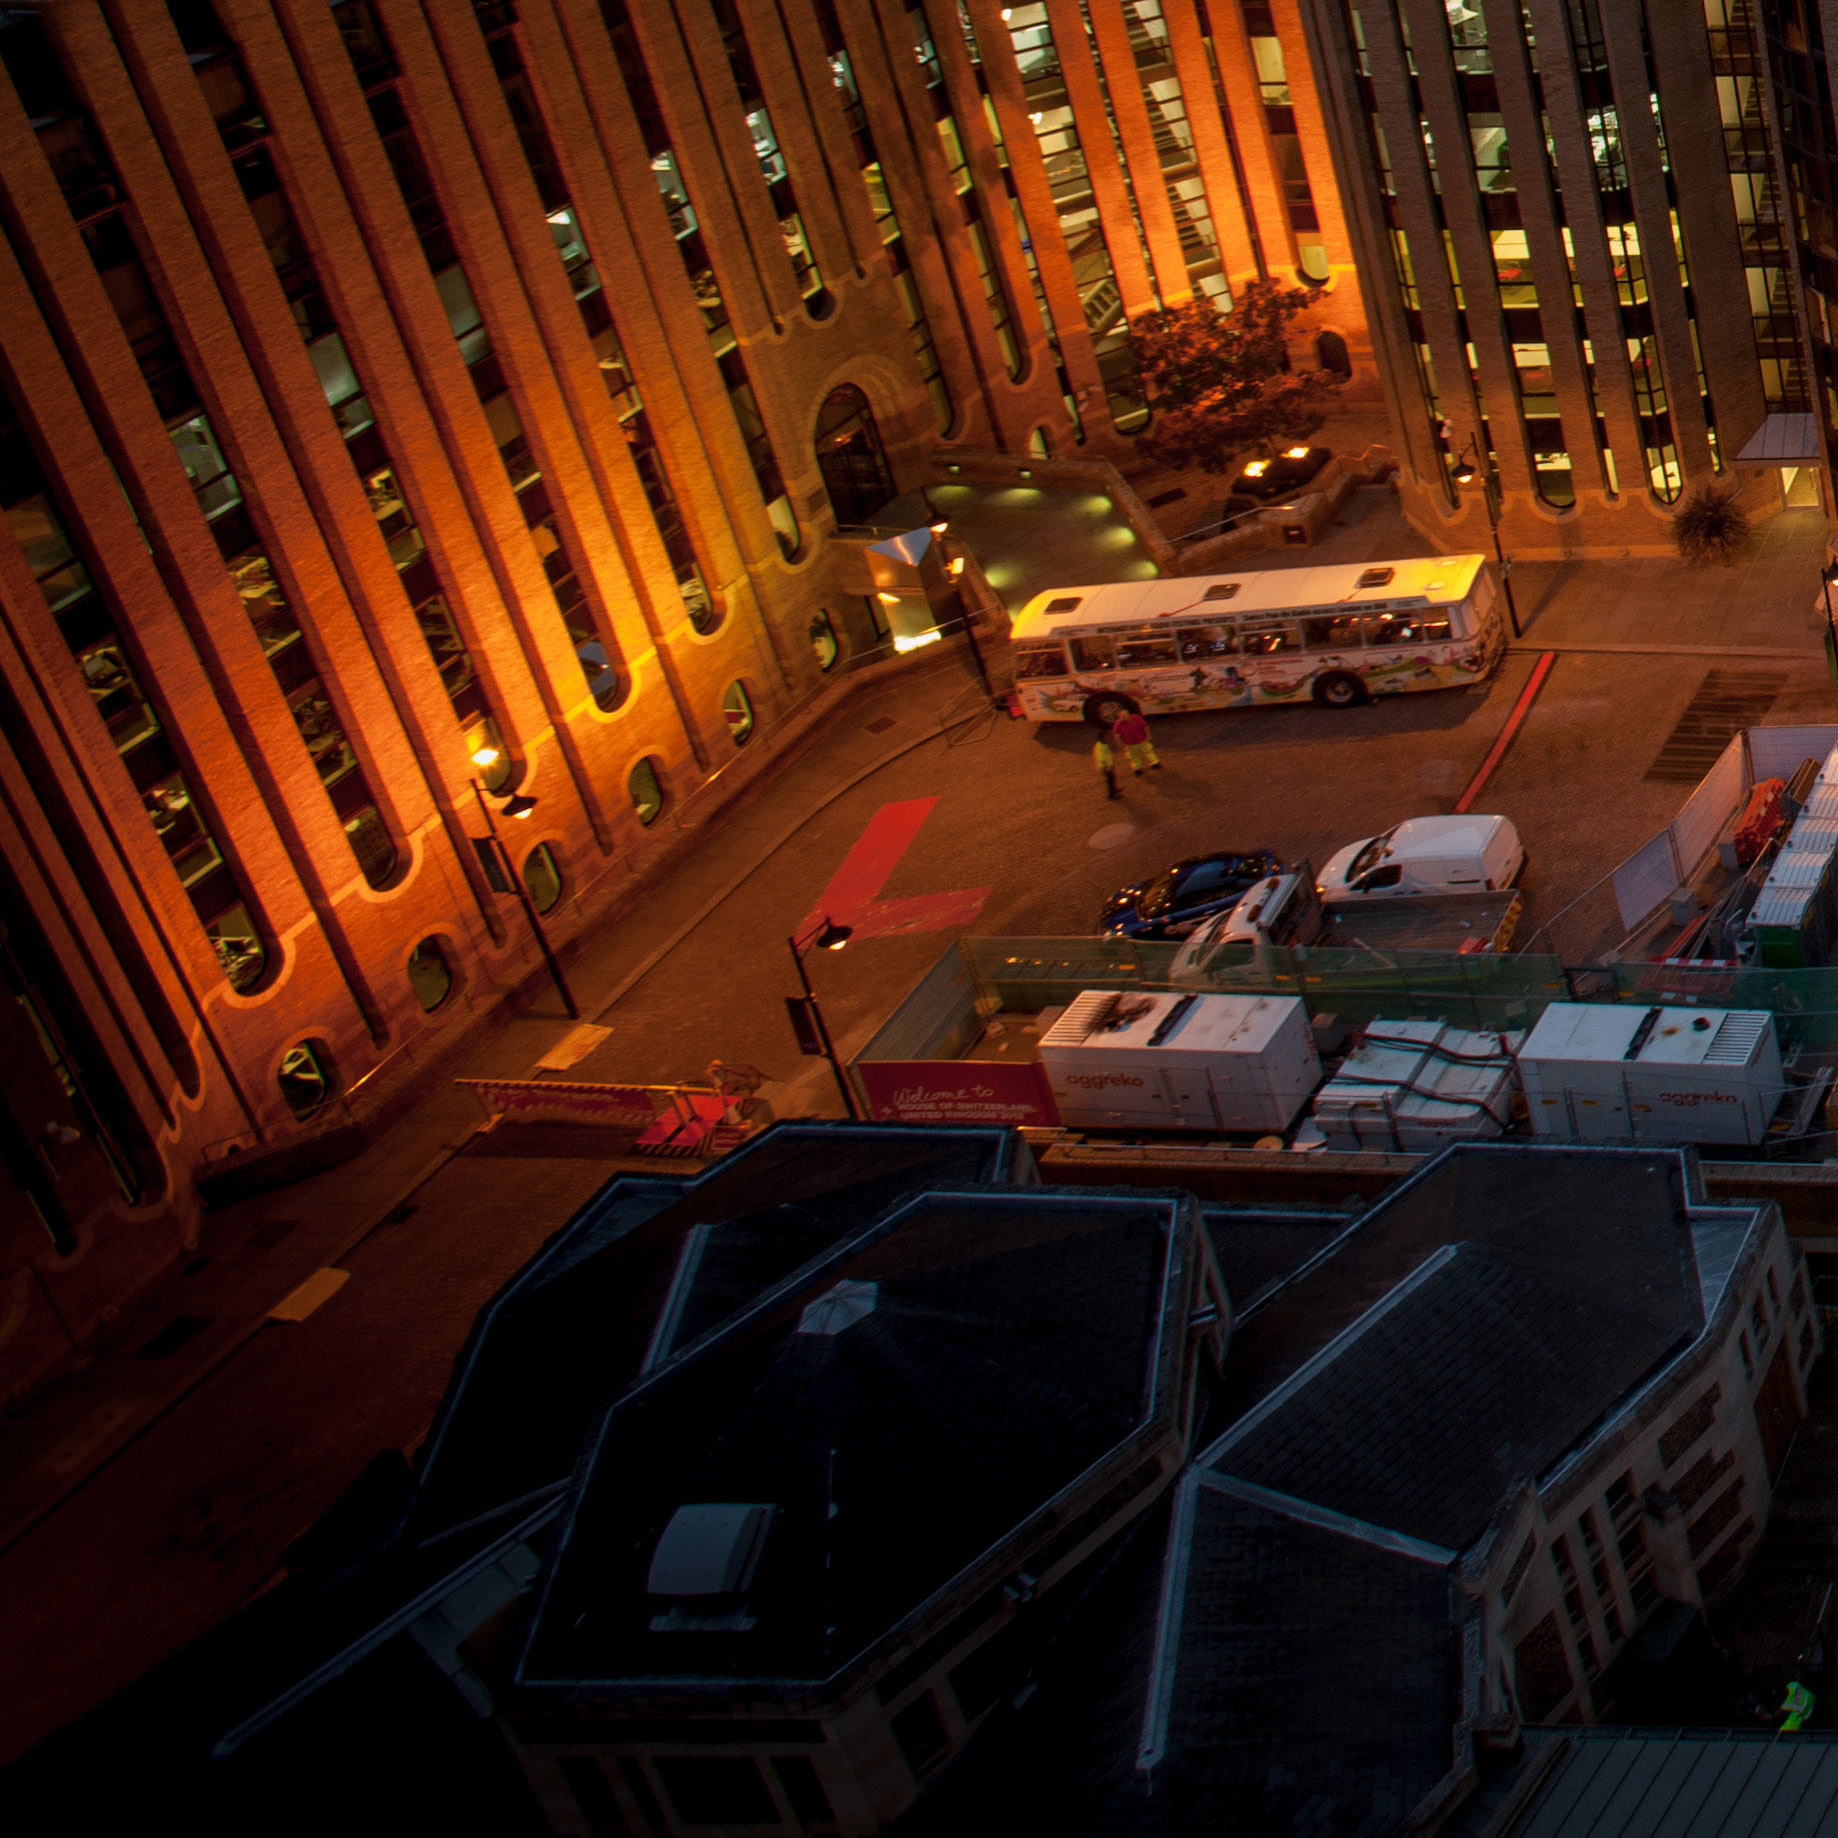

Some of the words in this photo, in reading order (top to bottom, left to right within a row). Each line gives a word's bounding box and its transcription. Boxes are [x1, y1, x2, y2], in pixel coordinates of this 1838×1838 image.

[1066, 1073, 1144, 1090] aggreko
[893, 1086, 970, 1105] Welcome
[971, 1083, 995, 1097] to
[1660, 1091, 1737, 1107] aggreko
[939, 1102, 953, 1110] OF
